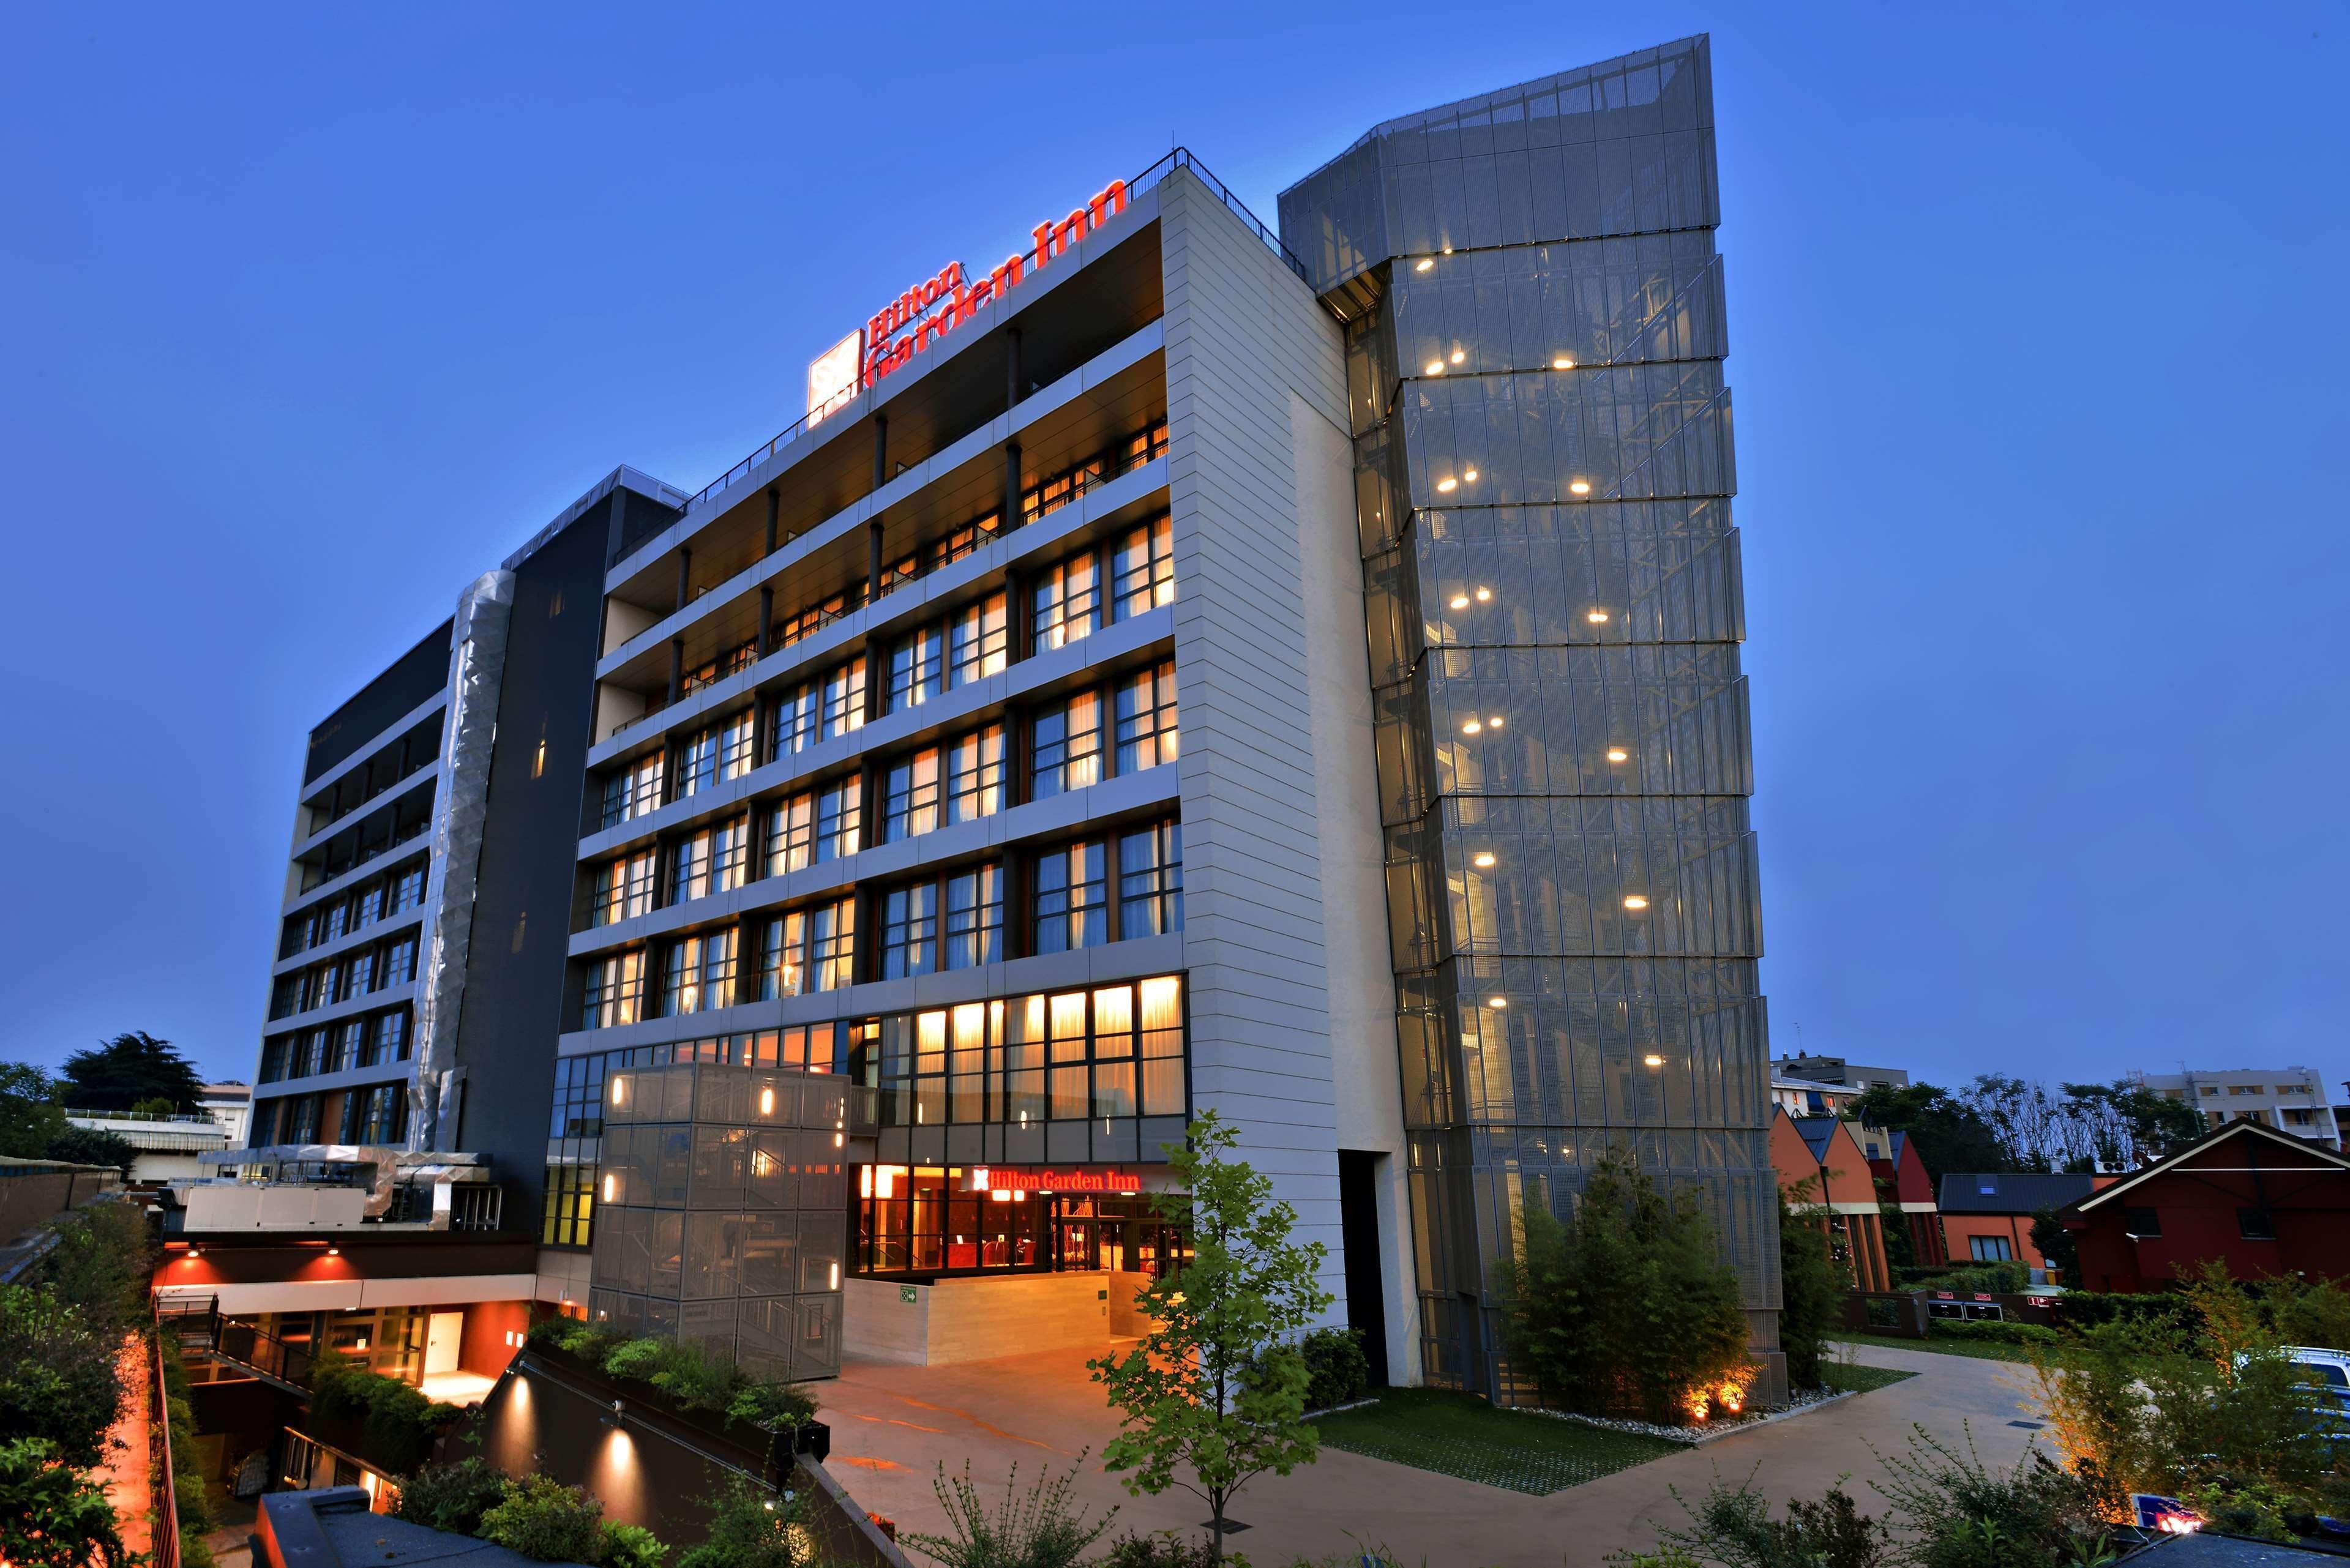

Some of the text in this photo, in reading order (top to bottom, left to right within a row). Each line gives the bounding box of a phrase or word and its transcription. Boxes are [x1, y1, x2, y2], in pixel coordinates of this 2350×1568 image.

[864, 179, 1126, 388] Garden Inn
[867, 260, 963, 349] Hilton
[989, 1170, 1140, 1190] Hilton Garden Inn
